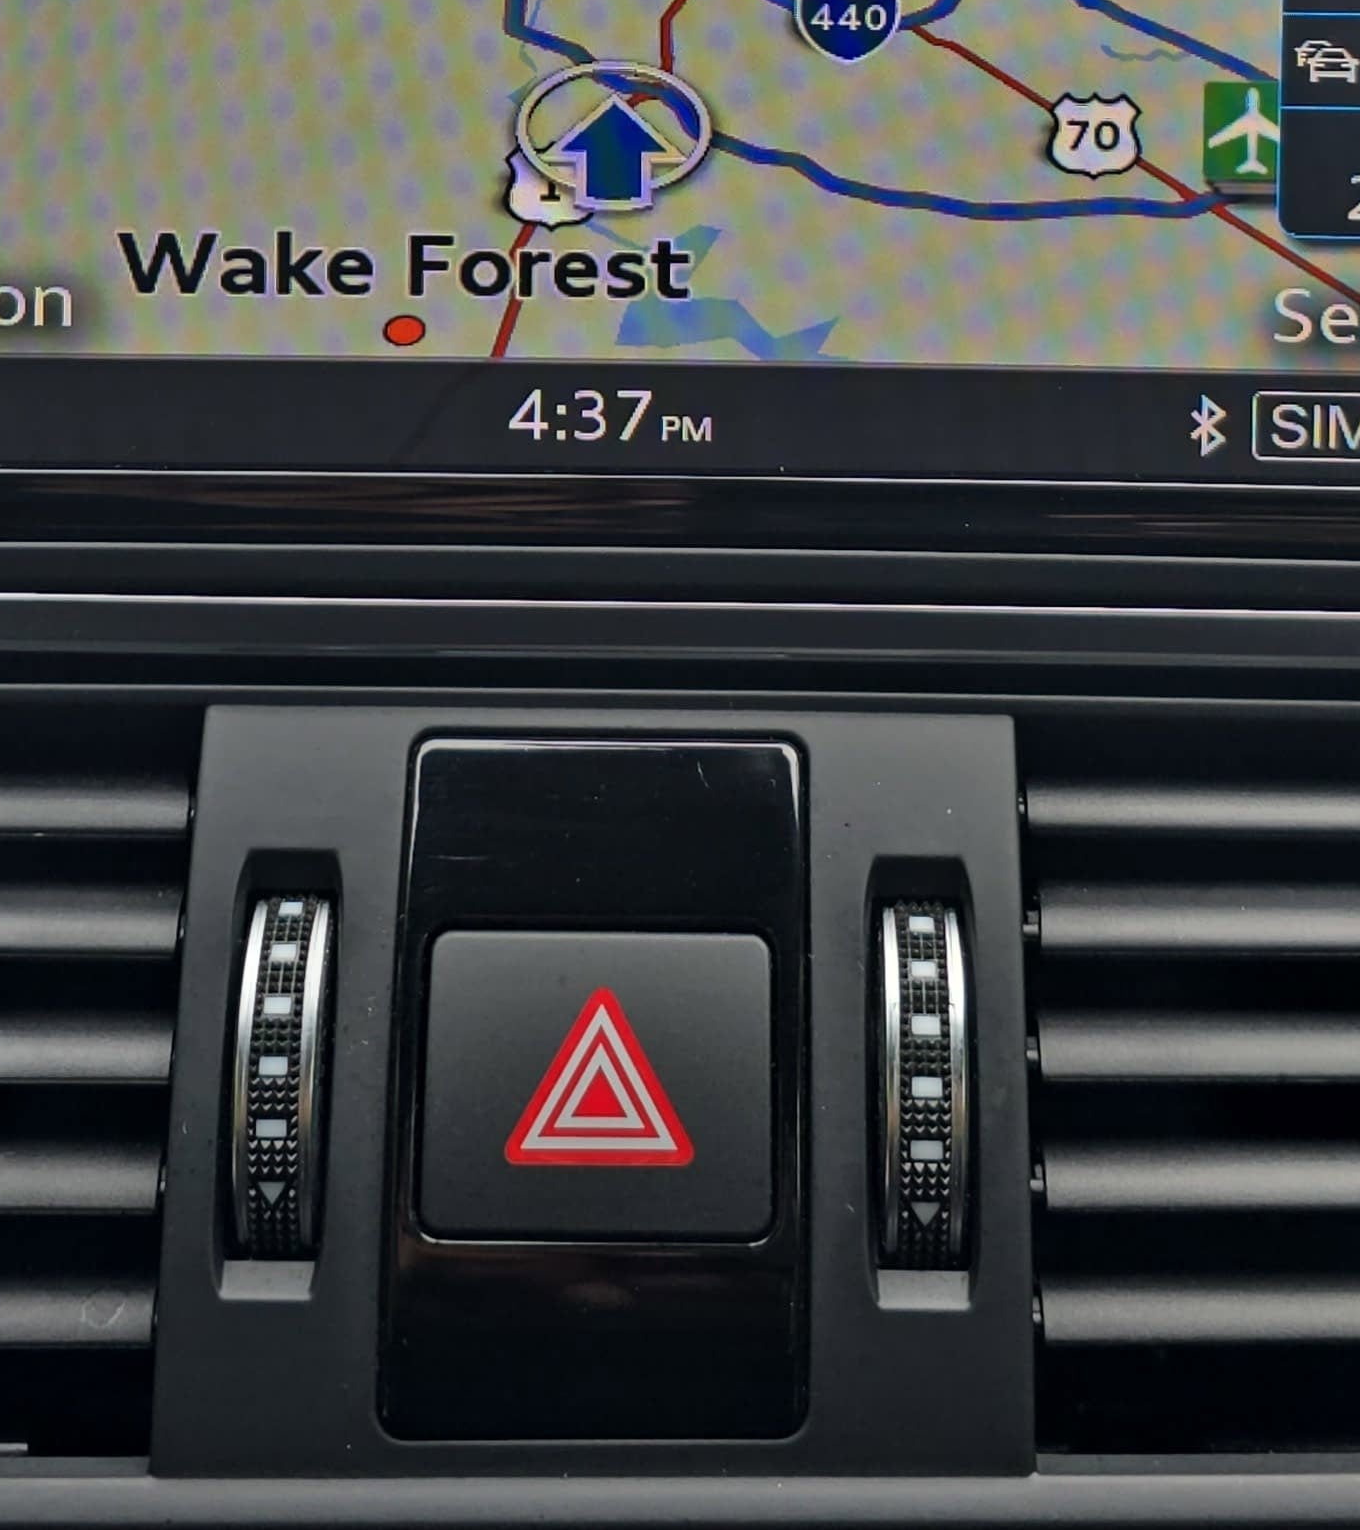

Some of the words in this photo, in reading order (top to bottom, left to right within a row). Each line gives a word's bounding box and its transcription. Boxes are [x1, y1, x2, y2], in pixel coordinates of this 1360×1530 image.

[809, 3, 888, 32] 440
[1065, 120, 1121, 151] 70
[118, 230, 374, 296] Wake
[408, 234, 691, 299] Forest
